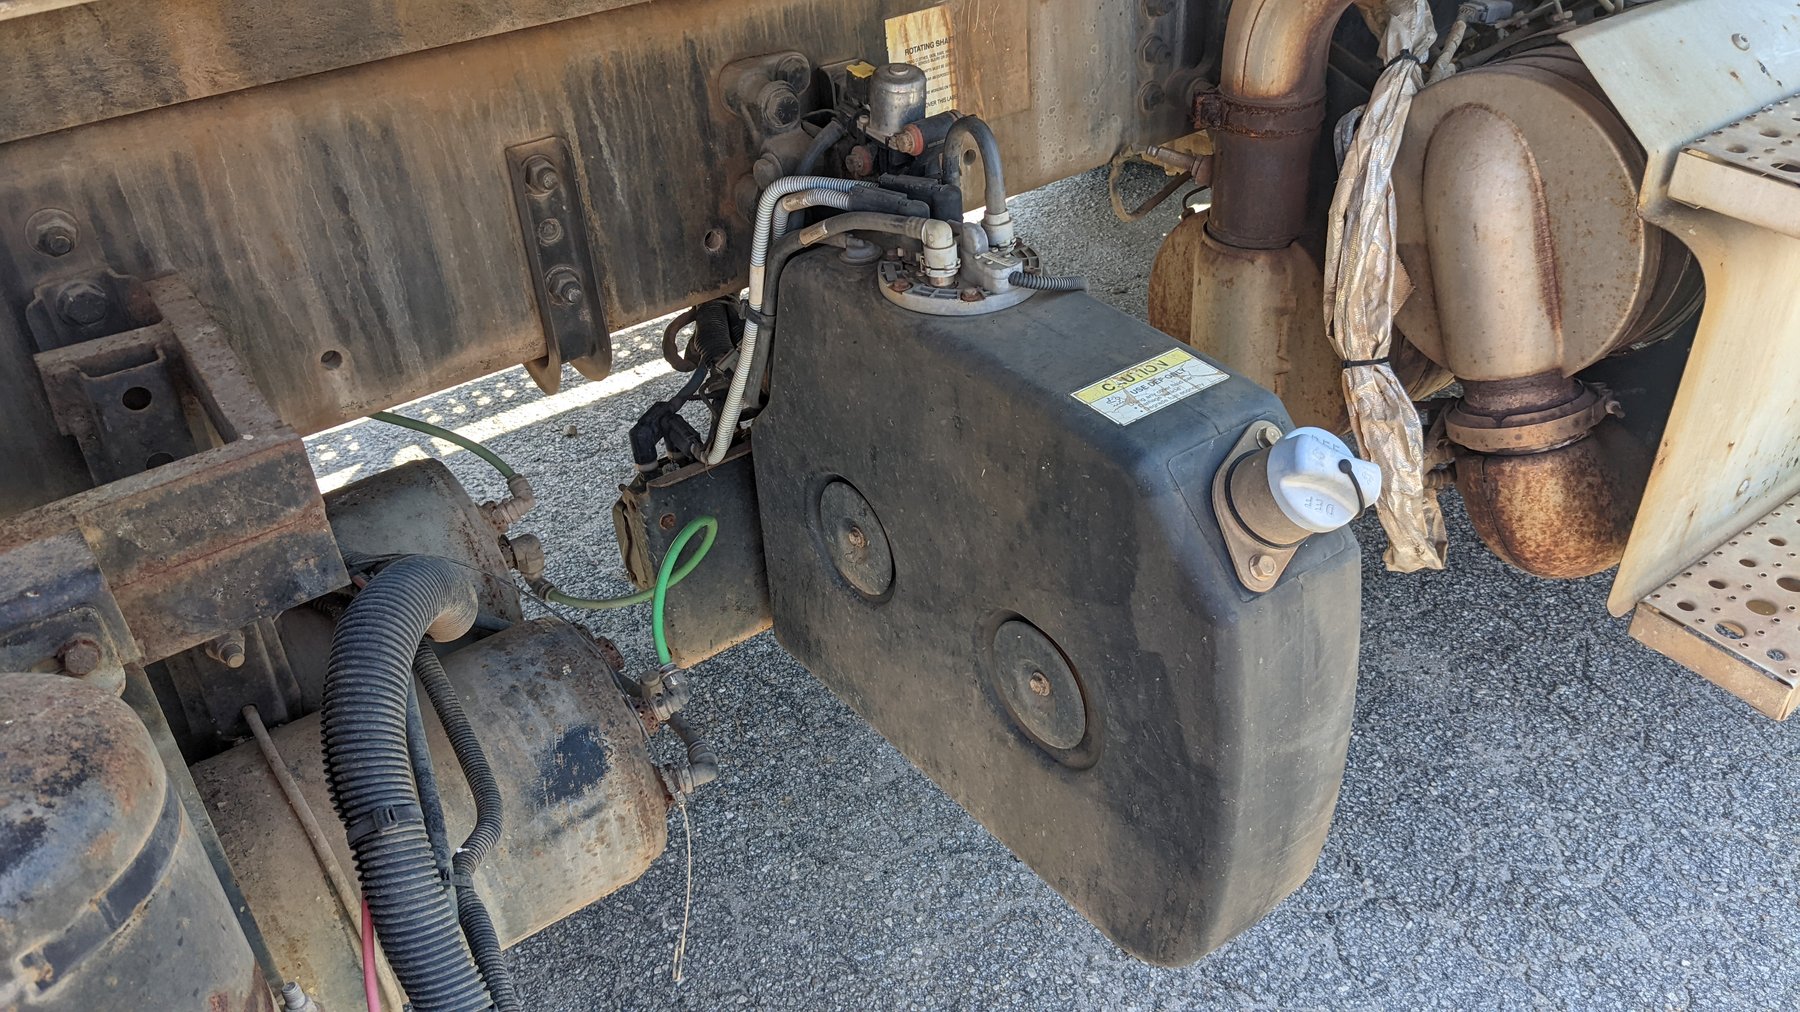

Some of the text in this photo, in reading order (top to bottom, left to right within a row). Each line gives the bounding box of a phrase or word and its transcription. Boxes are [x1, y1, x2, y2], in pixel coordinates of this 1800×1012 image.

[905, 42, 934, 55] ROTATING
[1130, 368, 1186, 394] USE DEF ONLY
[1304, 496, 1335, 517] DEF
